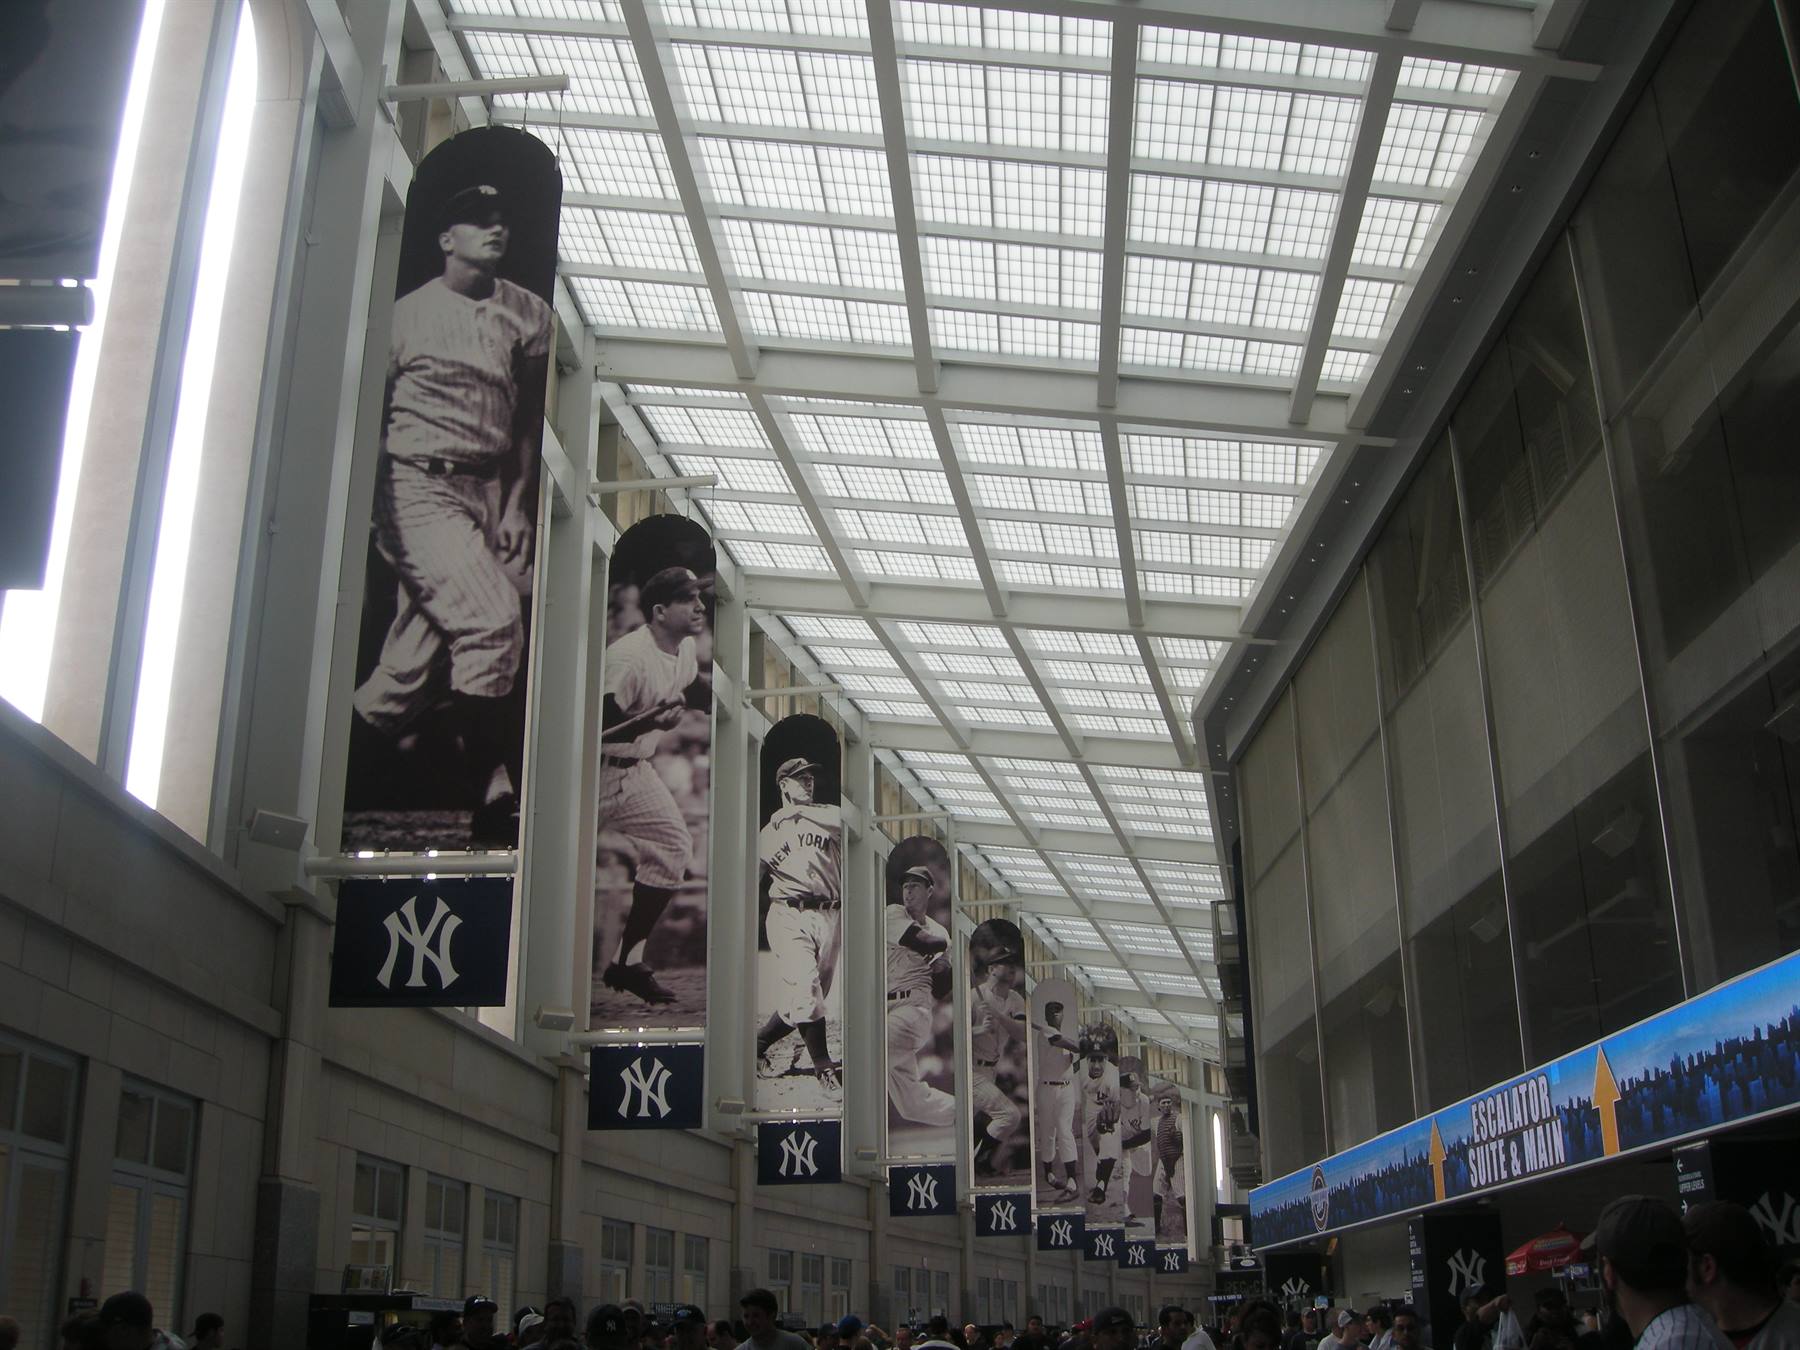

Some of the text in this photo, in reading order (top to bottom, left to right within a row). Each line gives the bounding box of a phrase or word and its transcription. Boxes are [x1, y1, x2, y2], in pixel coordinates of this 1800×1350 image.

[770, 841, 791, 870] NEW
[377, 895, 463, 989] NY
[618, 1057, 672, 1119] NY
[1472, 1075, 1551, 1144] ESCALATOR
[778, 1131, 818, 1177] NY
[1468, 1118, 1566, 1188] SUITE & MAIN
[907, 1173, 939, 1209] NY
[990, 1201, 1017, 1231] NY
[1050, 1219, 1073, 1246] NY
[1094, 1233, 1115, 1258] NY
[1128, 1244, 1145, 1265] NY
[1164, 1252, 1180, 1271] NY
[1447, 1248, 1487, 1297] NY
